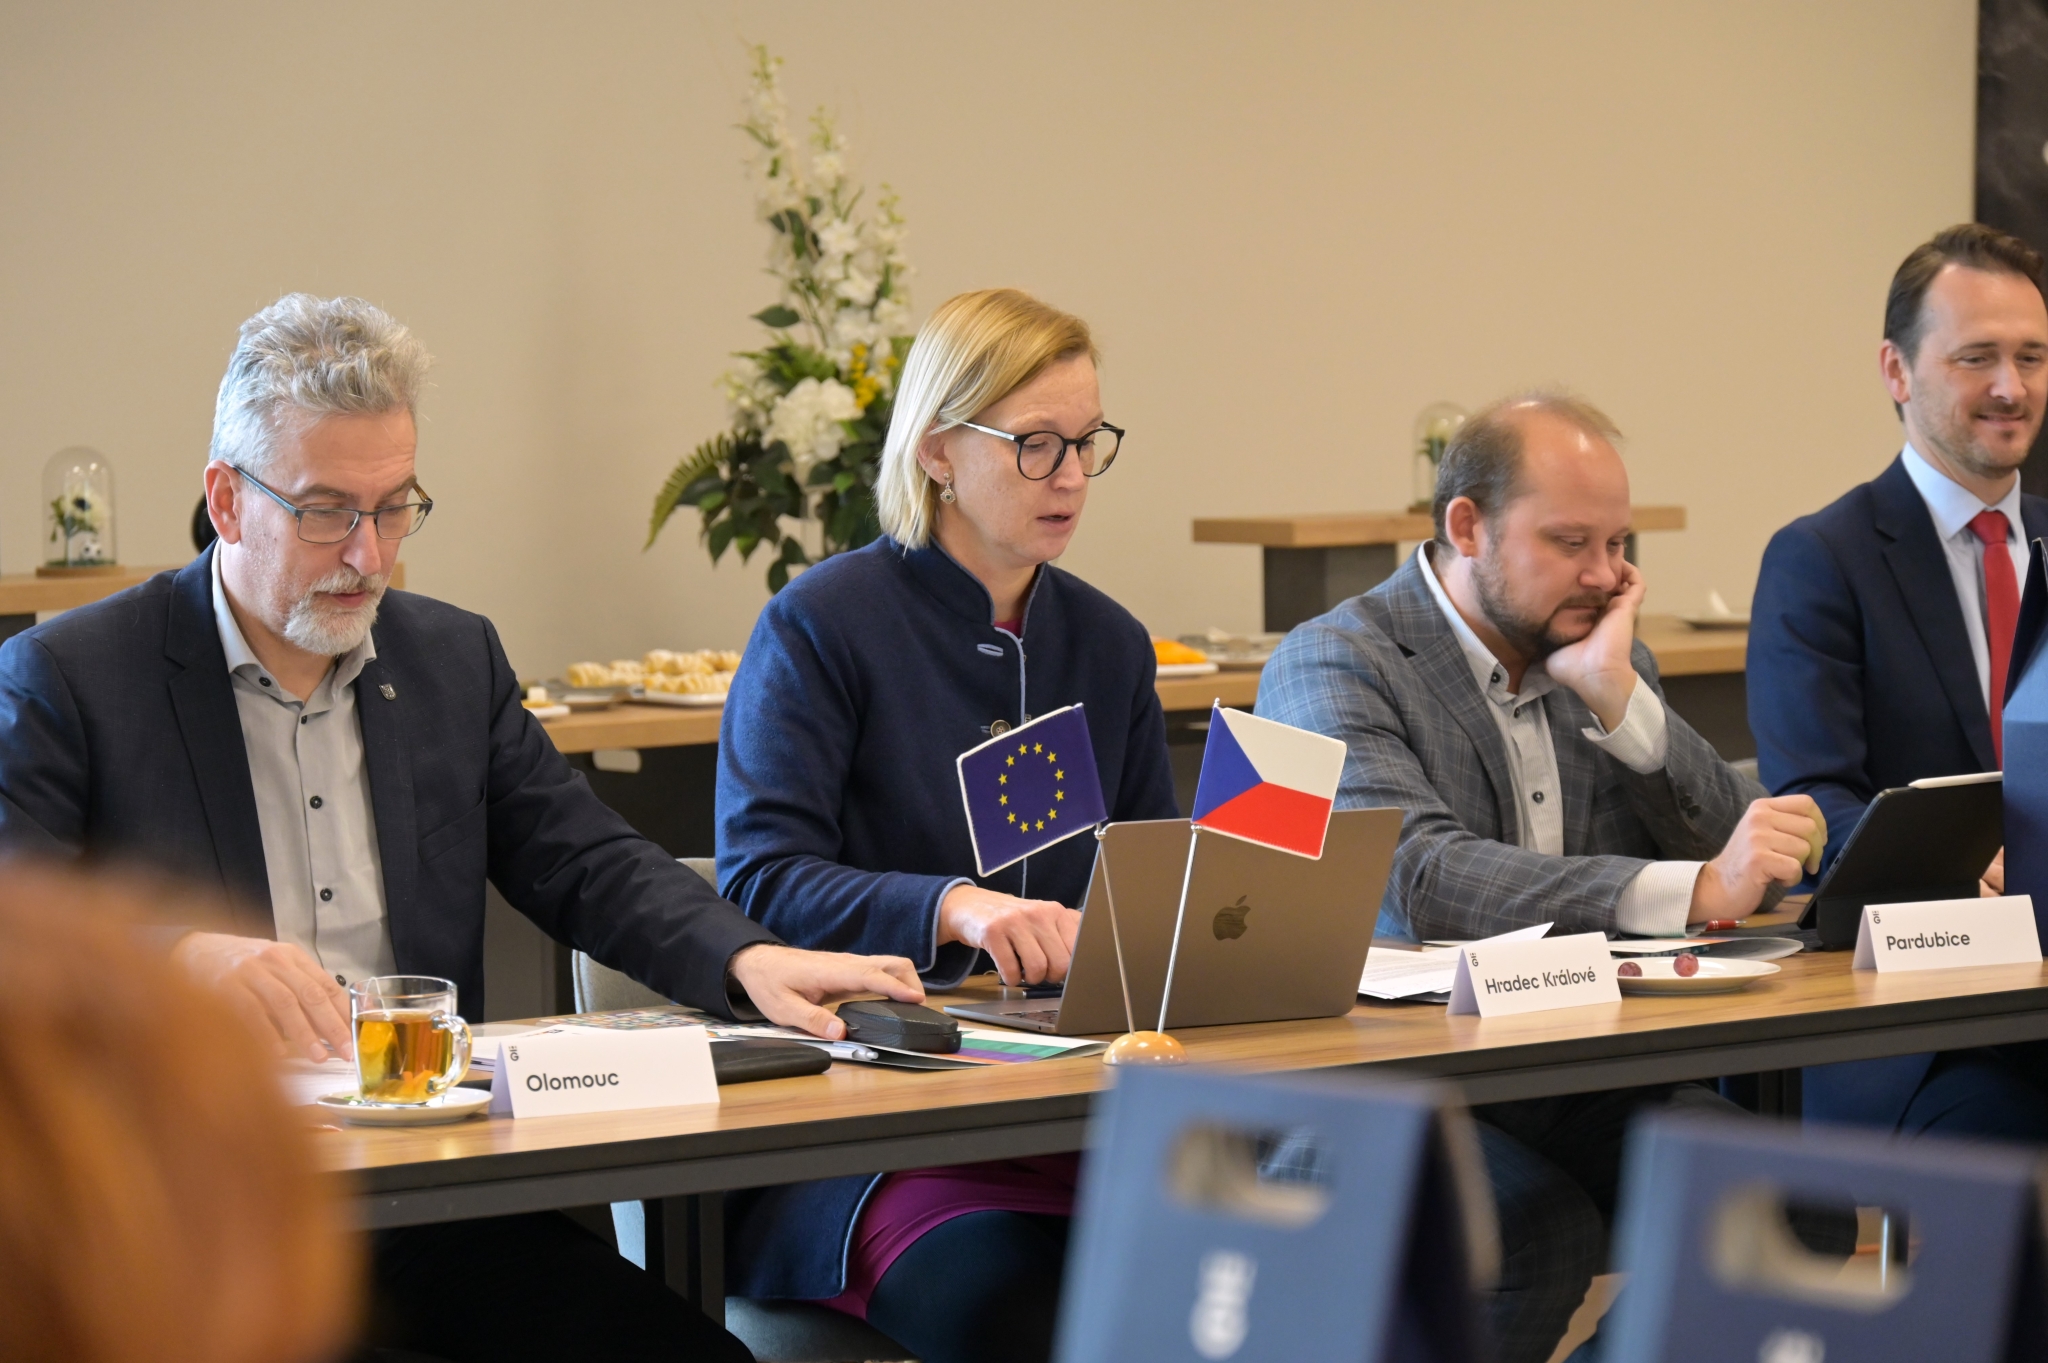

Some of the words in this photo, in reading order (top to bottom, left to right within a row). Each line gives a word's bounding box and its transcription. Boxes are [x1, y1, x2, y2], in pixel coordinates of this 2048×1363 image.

[1886, 931, 1971, 951] Pardubice
[1484, 974, 1540, 995] Hradec
[1542, 966, 1596, 988] Králové
[526, 1072, 620, 1092] Olomouc
